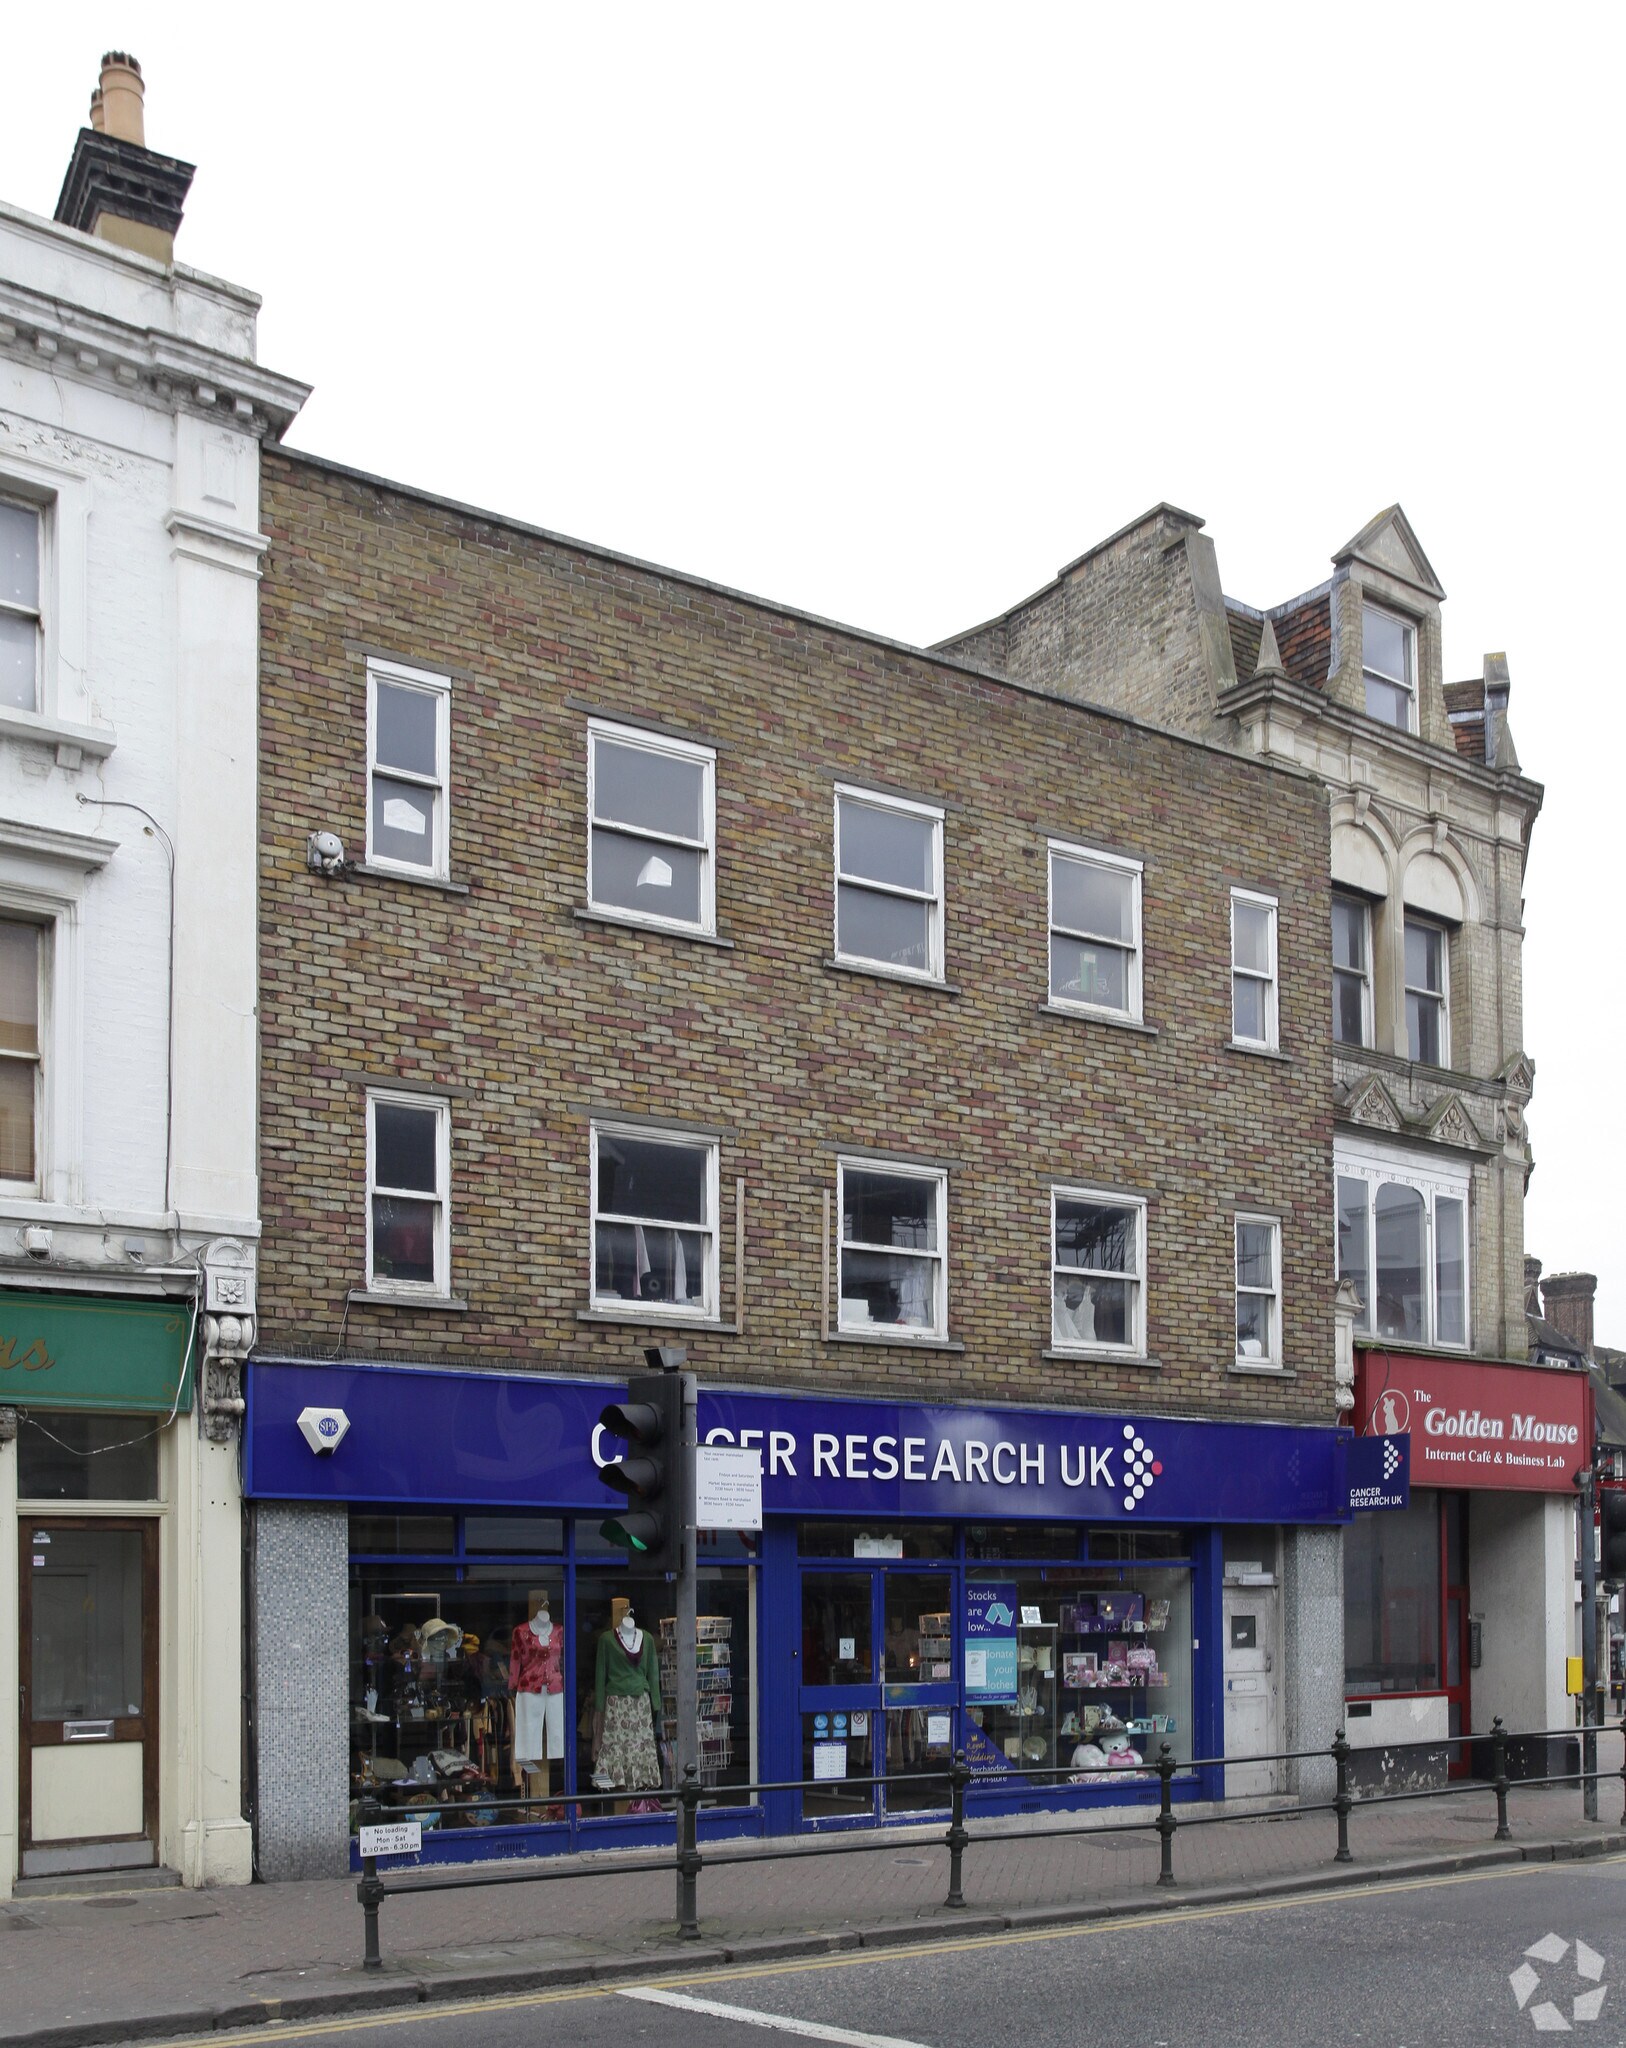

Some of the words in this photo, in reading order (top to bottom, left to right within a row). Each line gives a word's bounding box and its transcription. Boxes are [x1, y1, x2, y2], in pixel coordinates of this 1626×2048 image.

[1413, 1389, 1432, 1403] The
[319, 1421, 338, 1432] SPE
[1424, 1407, 1504, 1440] Golden
[1509, 1413, 1579, 1446] Mouse
[813, 1432, 1045, 1485] RESEARCH
[1060, 1444, 1116, 1487] UK
[1425, 1447, 1466, 1462] Internet
[1468, 1449, 1492, 1464] Café
[1493, 1454, 1503, 1464] &
[1505, 1453, 1545, 1467] Business
[1547, 1455, 1565, 1469] Lab
[1350, 1487, 1381, 1498] CANCER
[1350, 1496, 1390, 1507] RESEARCH
[1391, 1495, 1403, 1505] UK
[967, 1590, 997, 1601] Stocks
[967, 1607, 983, 1617] are
[967, 1621, 991, 1632] low...
[994, 1665, 1015, 1677] your
[966, 1739, 986, 1754] Royal
[966, 1753, 996, 1764] Wedding
[384, 1826, 408, 1834] loading
